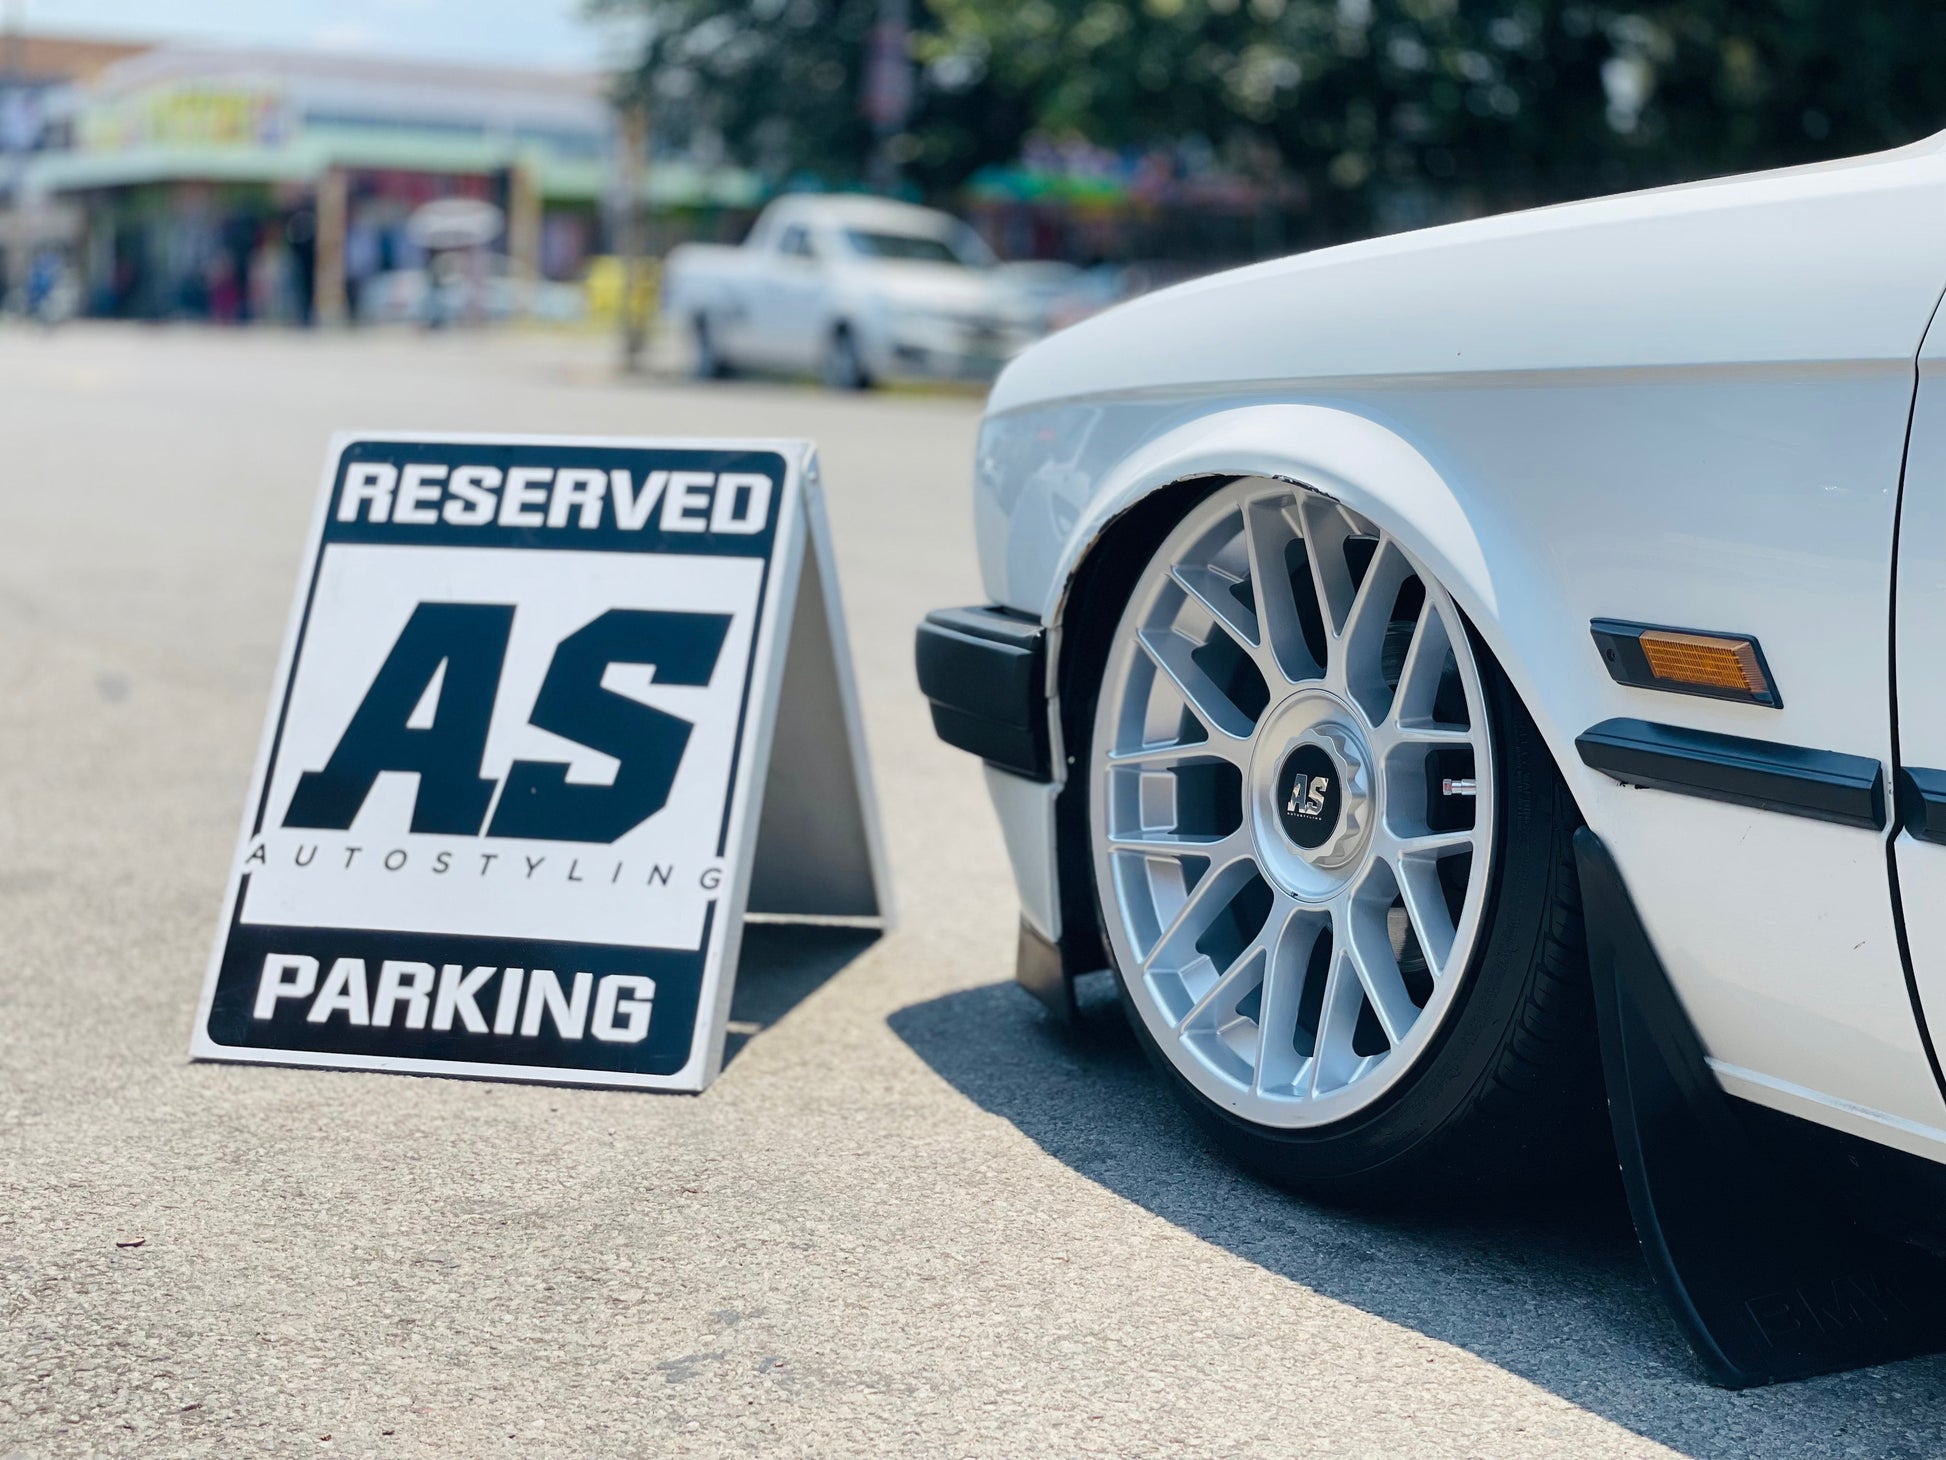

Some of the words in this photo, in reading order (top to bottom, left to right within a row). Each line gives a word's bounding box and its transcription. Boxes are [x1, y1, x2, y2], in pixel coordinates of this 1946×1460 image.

[337, 462, 774, 534] RESERVED
[280, 601, 735, 844] AS
[1287, 774, 1329, 815] AS
[246, 844, 723, 890] AUTOSTYLING
[253, 953, 656, 1044] PARKING
